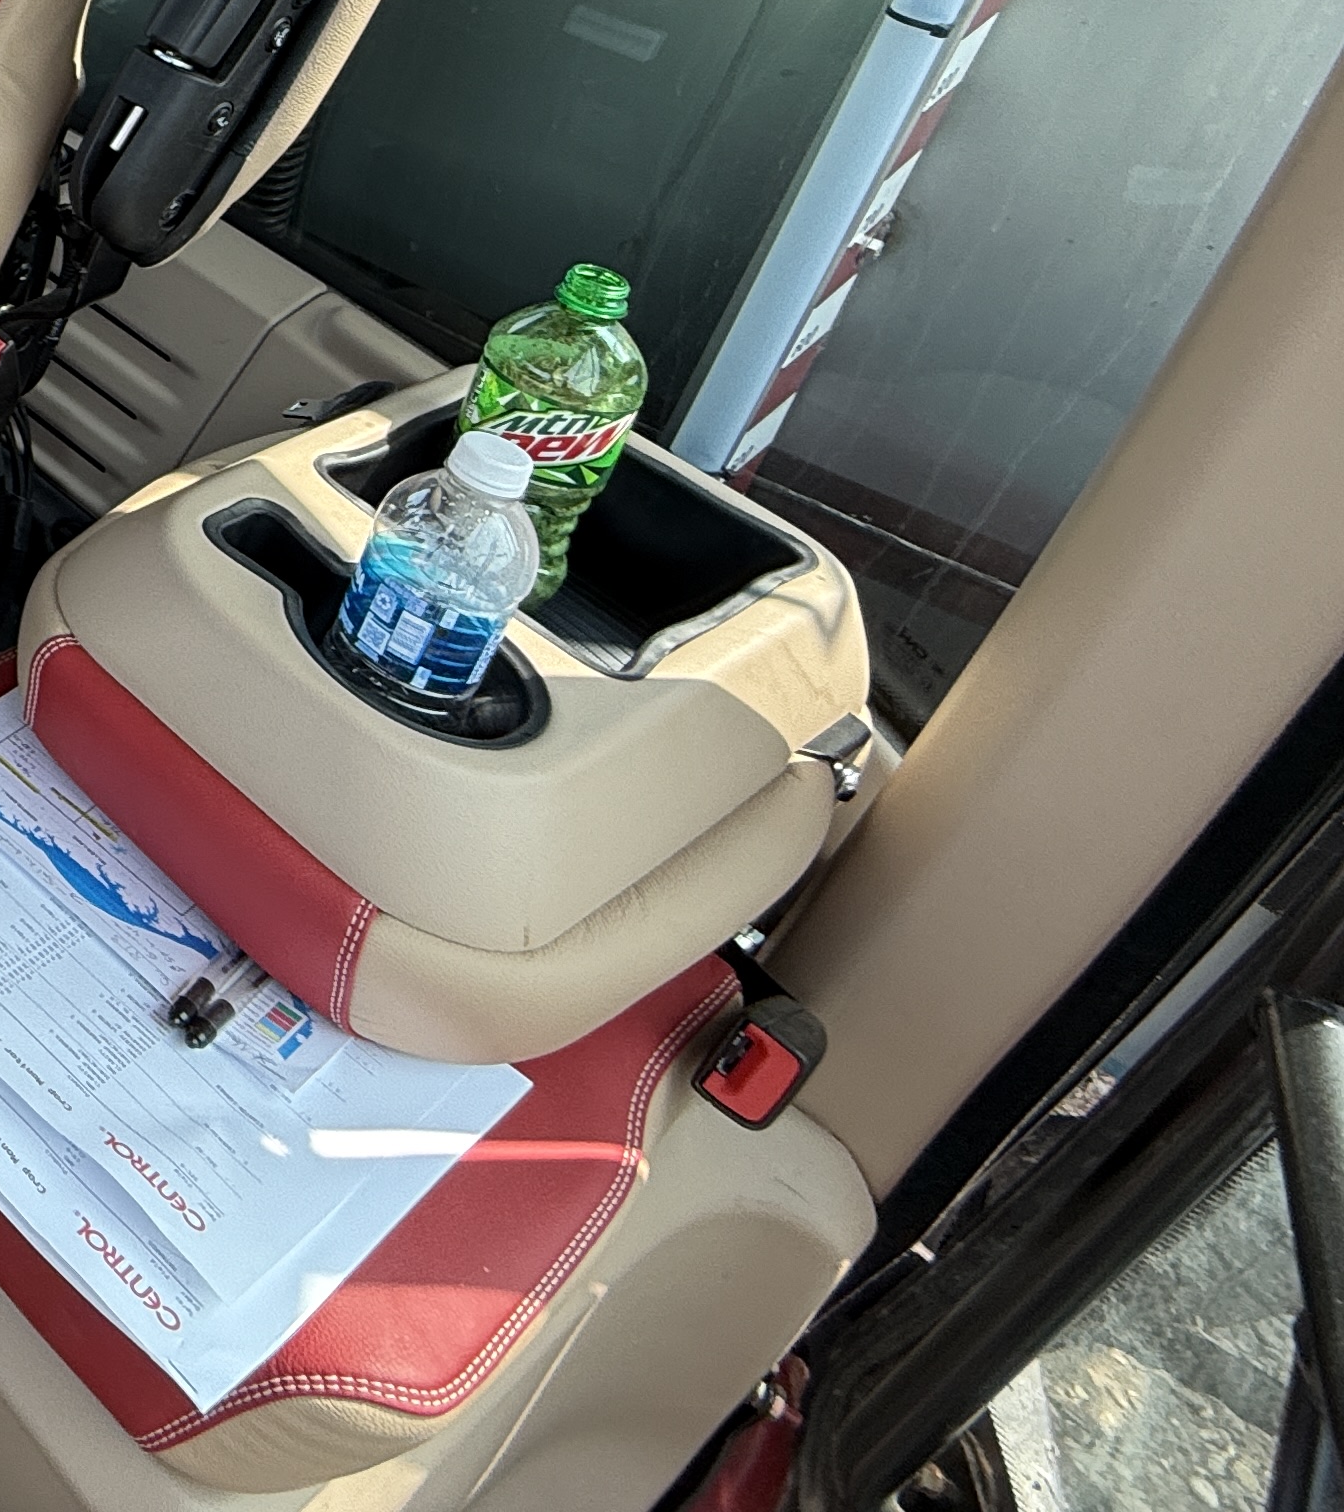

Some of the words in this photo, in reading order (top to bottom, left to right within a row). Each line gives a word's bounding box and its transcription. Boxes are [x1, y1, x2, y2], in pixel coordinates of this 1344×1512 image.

[4, 1047, 44, 1085] Monitor
[47, 1088, 71, 1110] Crop
[22, 1167, 46, 1193] Crop
[104, 1131, 205, 1230] CENTROL
[76, 1216, 180, 1330] CENTROL
